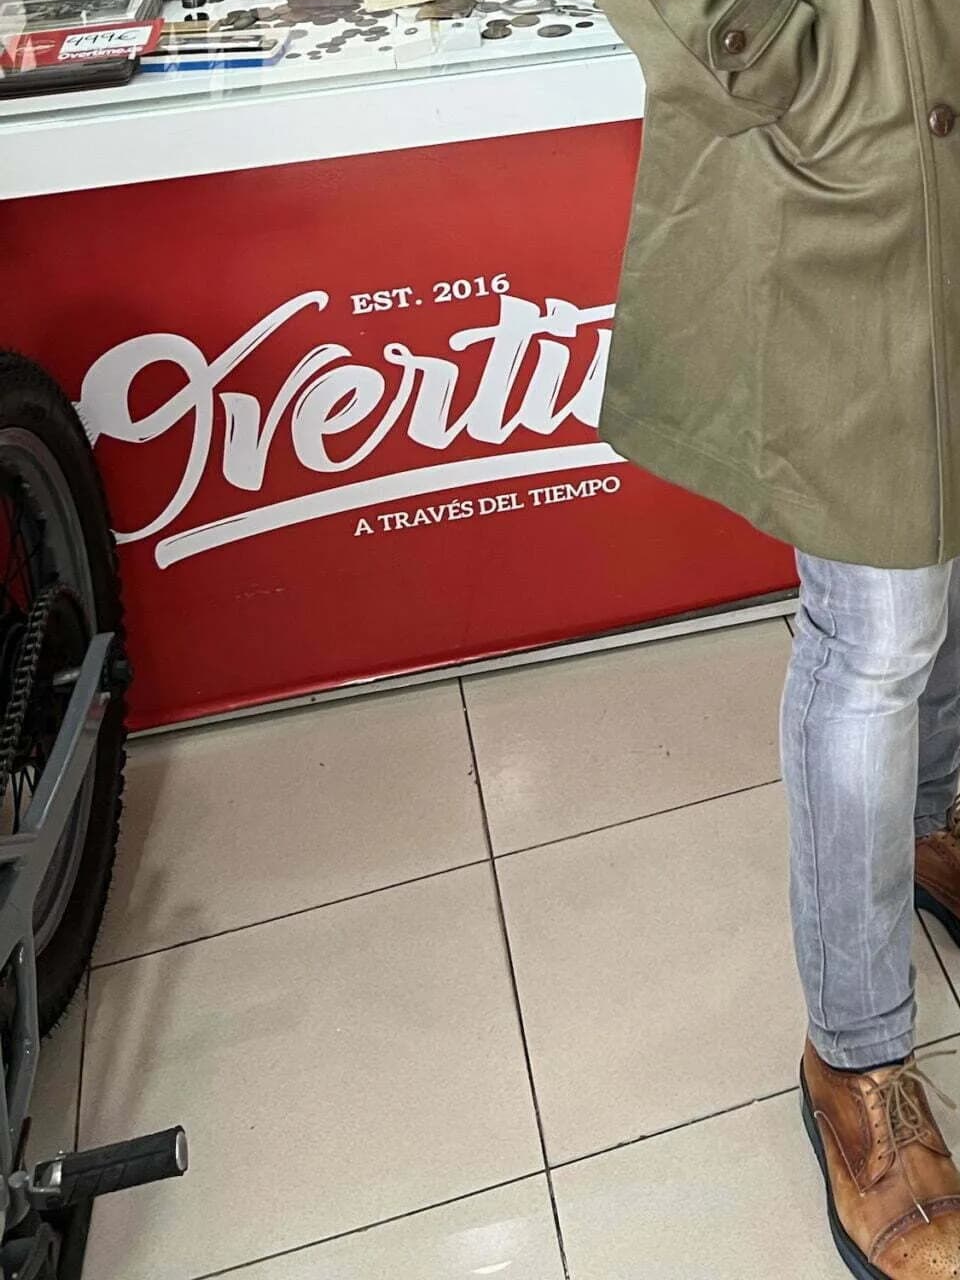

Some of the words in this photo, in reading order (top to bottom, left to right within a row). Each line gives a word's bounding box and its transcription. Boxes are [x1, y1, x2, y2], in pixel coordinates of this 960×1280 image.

[351, 290, 422, 315] EST.
[433, 273, 511, 305] 2016
[354, 517, 375, 537] A
[377, 500, 475, 535] TRAVÉS
[477, 492, 525, 517] DEL
[532, 475, 622, 507] TIEMPO
